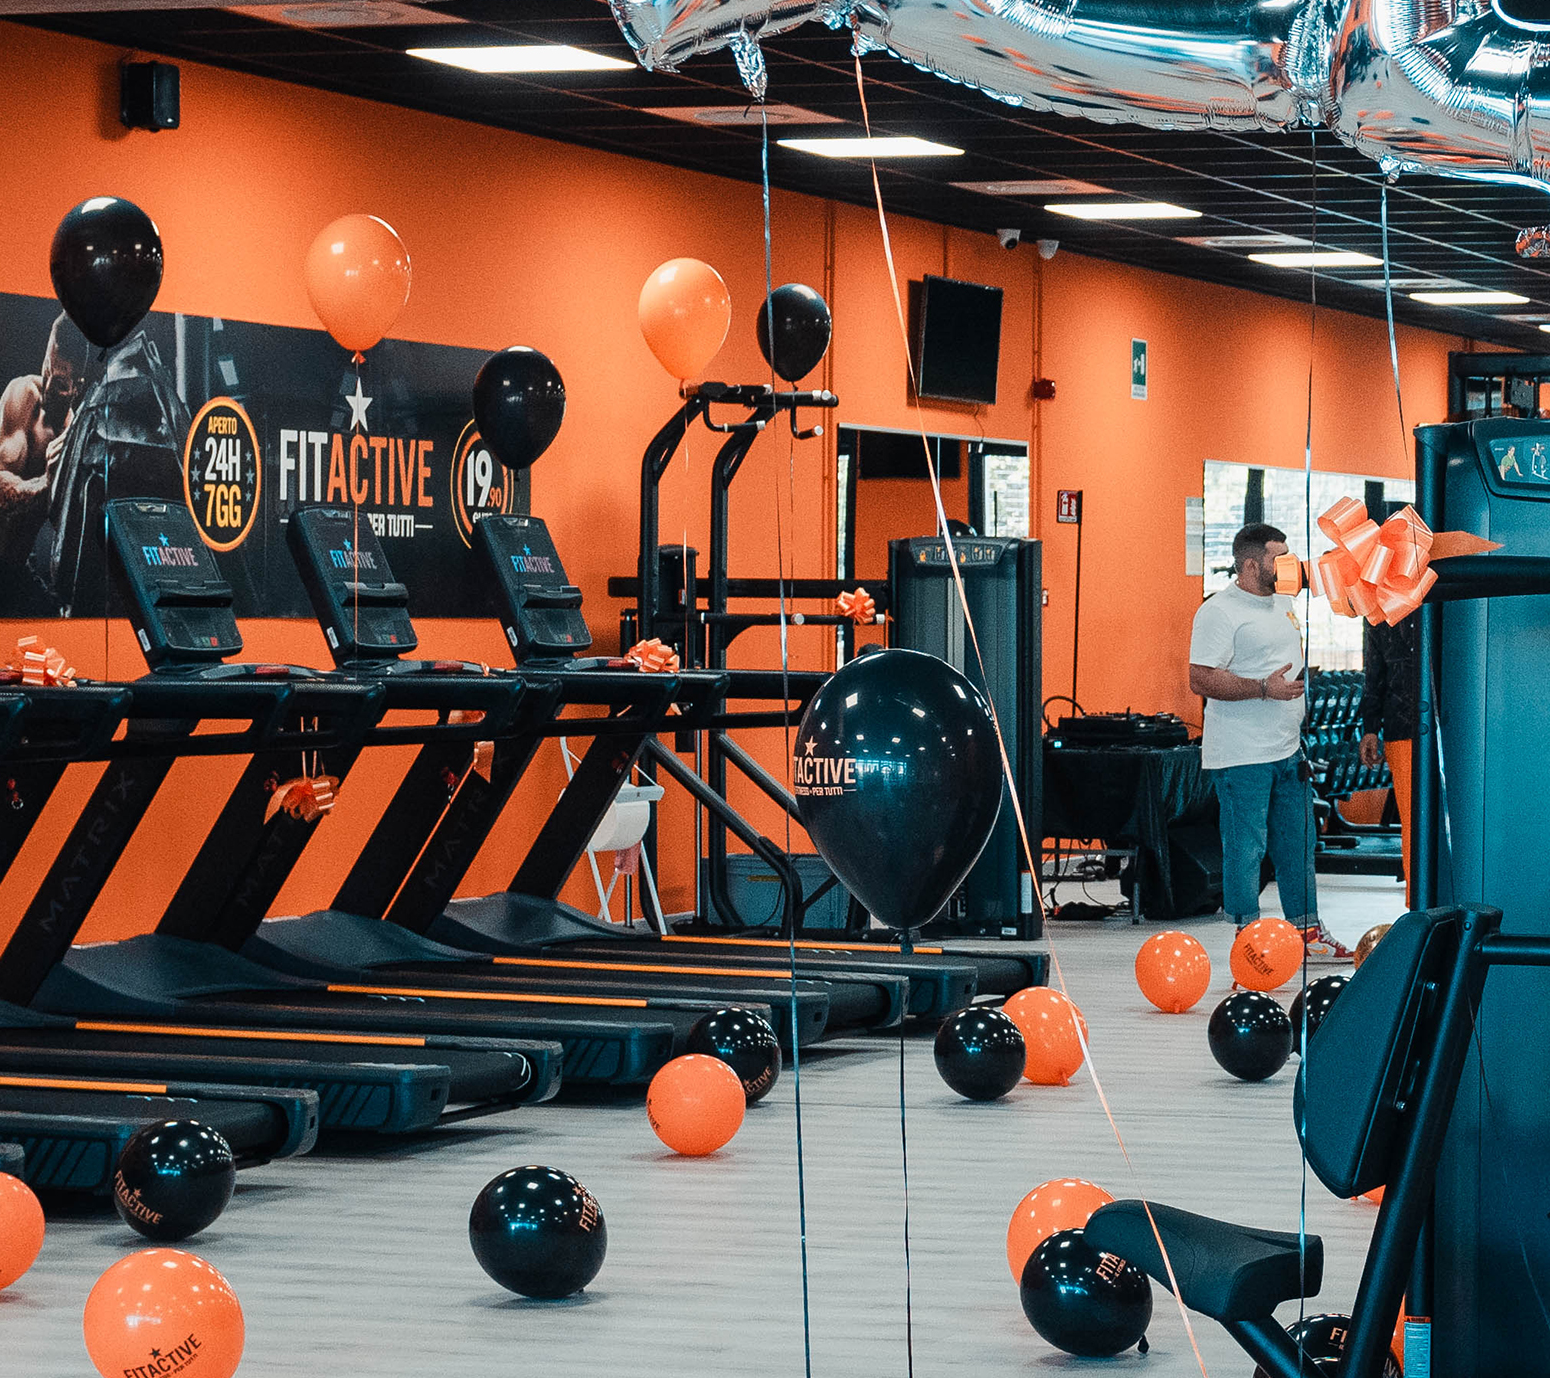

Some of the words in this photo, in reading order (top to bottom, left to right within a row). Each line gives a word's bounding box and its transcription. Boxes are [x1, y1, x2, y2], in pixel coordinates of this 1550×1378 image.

[207, 416, 238, 435] APERTO
[205, 437, 241, 482] 24H
[279, 428, 434, 508] FITACTIVE
[205, 483, 242, 528] 7GG
[387, 514, 415, 538] TUTTI
[142, 546, 199, 566] FITACTIVE
[511, 555, 555, 573] FITACTIVE
[793, 756, 857, 785] TACTIVE
[812, 786, 824, 796] PER
[825, 786, 844, 796] TUTTI
